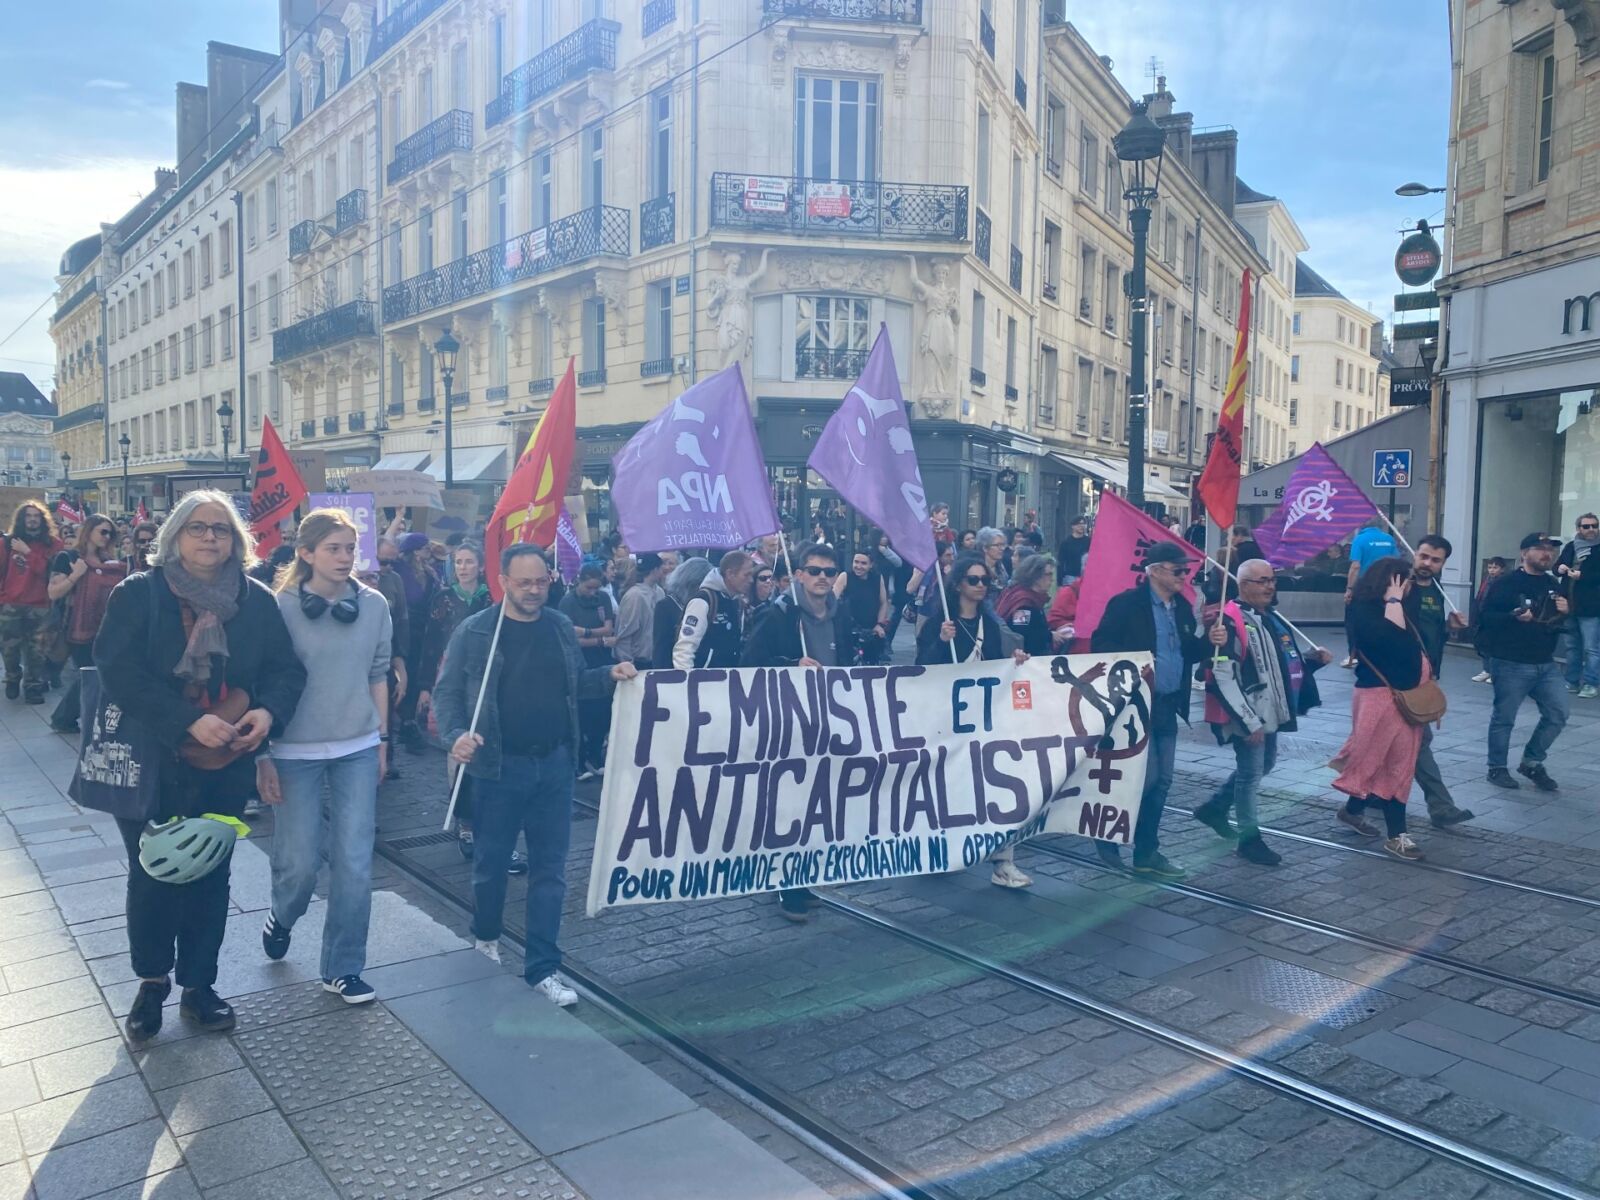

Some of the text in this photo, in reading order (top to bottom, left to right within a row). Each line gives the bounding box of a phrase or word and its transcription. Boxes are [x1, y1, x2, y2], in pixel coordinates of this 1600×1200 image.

[1253, 487, 1268, 498] La
[634, 665, 1001, 768] FEMINISTE ET
[616, 735, 1103, 861] ANTICAPITALISTE
[1078, 801, 1131, 844] NPA
[607, 866, 675, 905] POUR
[678, 860, 710, 900] UN
[709, 851, 782, 896] MONDE
[779, 849, 824, 889] SANS
